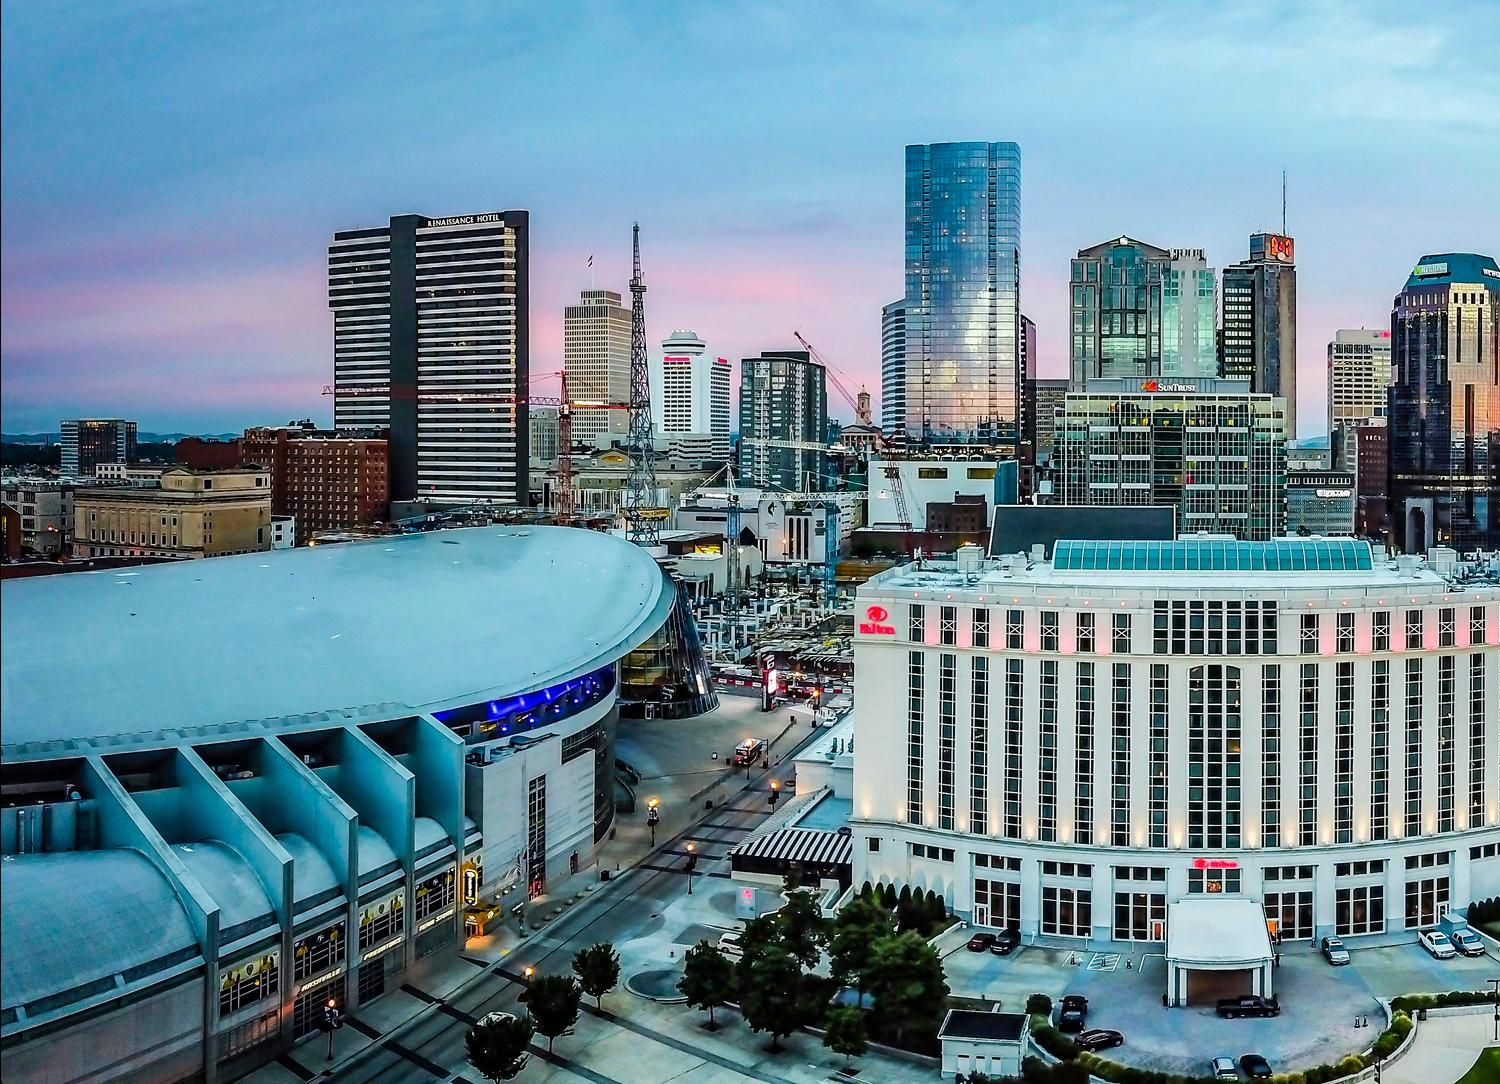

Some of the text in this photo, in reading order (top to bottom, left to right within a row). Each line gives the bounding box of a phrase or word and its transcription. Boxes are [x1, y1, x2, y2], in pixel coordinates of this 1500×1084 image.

[427, 214, 500, 227] RENAISSANCE HOTEL
[301, 967, 341, 991] NASHVILLE
